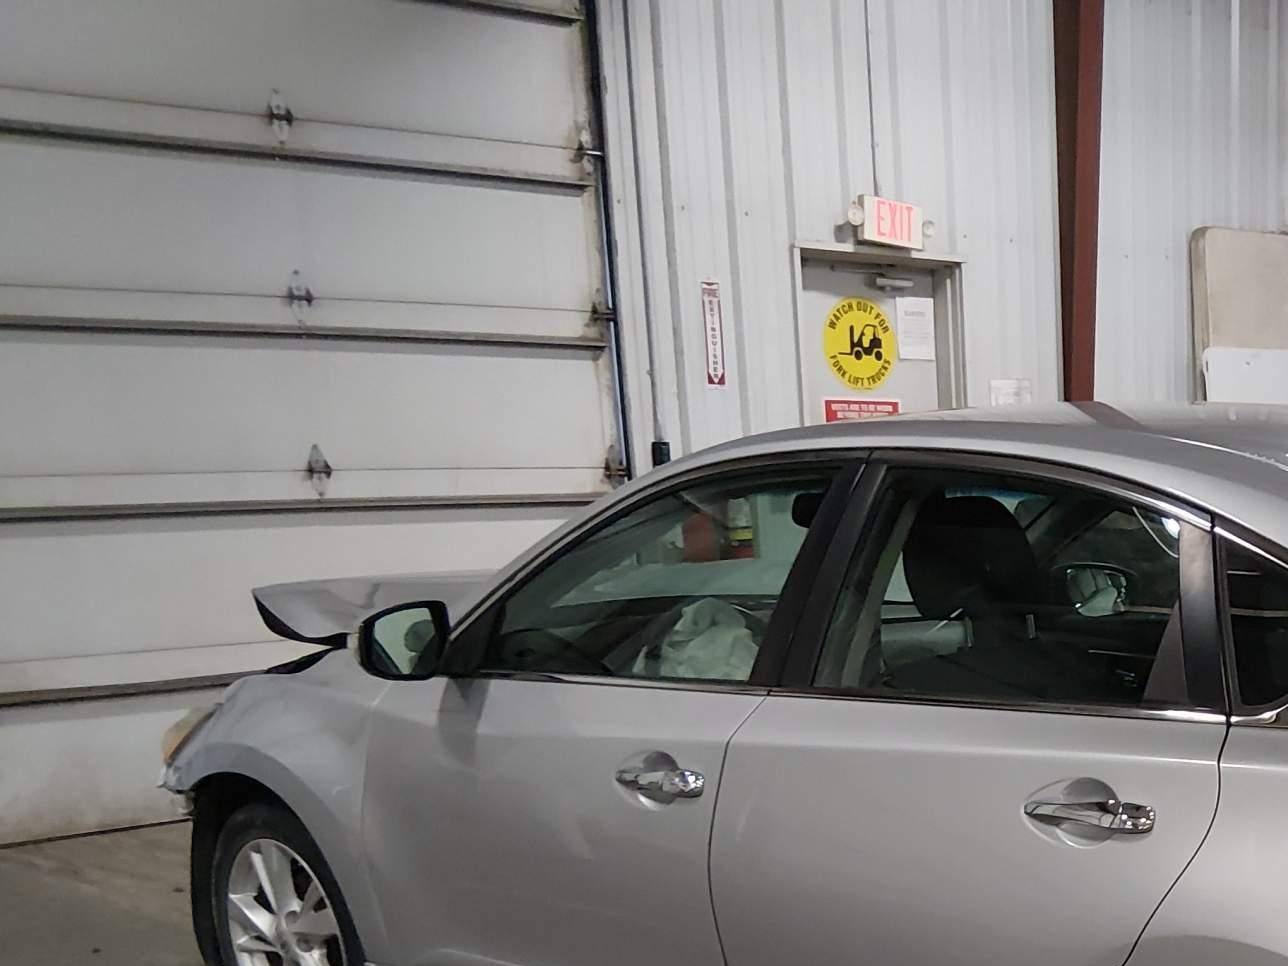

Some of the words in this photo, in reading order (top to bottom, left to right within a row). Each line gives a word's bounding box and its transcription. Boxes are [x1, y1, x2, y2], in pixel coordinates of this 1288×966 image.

[876, 199, 914, 242] EXIT
[828, 301, 854, 330] WATCH
[856, 301, 875, 316] OUT
[873, 312, 891, 334] FOR
[829, 354, 847, 379] FORK
[847, 374, 865, 387] LIFT
[866, 358, 892, 386] TRUCKS
